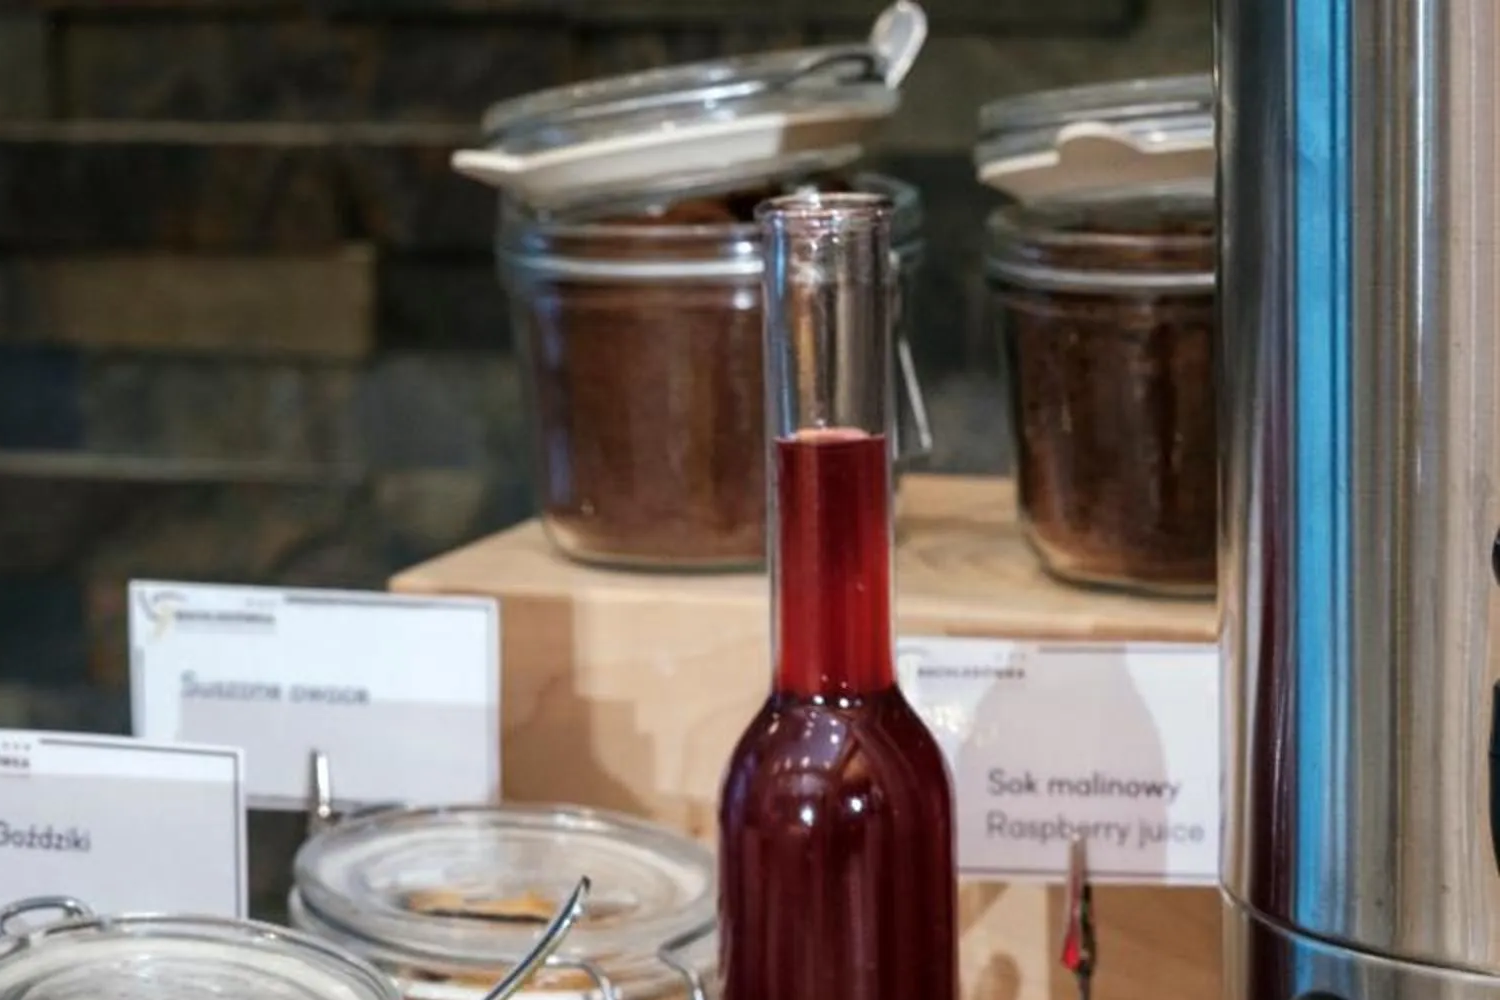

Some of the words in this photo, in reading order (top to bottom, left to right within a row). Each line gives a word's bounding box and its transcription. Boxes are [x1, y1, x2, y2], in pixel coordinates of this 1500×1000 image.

[988, 768, 1037, 797] Sok
[1047, 772, 1182, 804] malinowy
[986, 810, 1131, 846] Raspberry
[1138, 816, 1206, 849] juice
